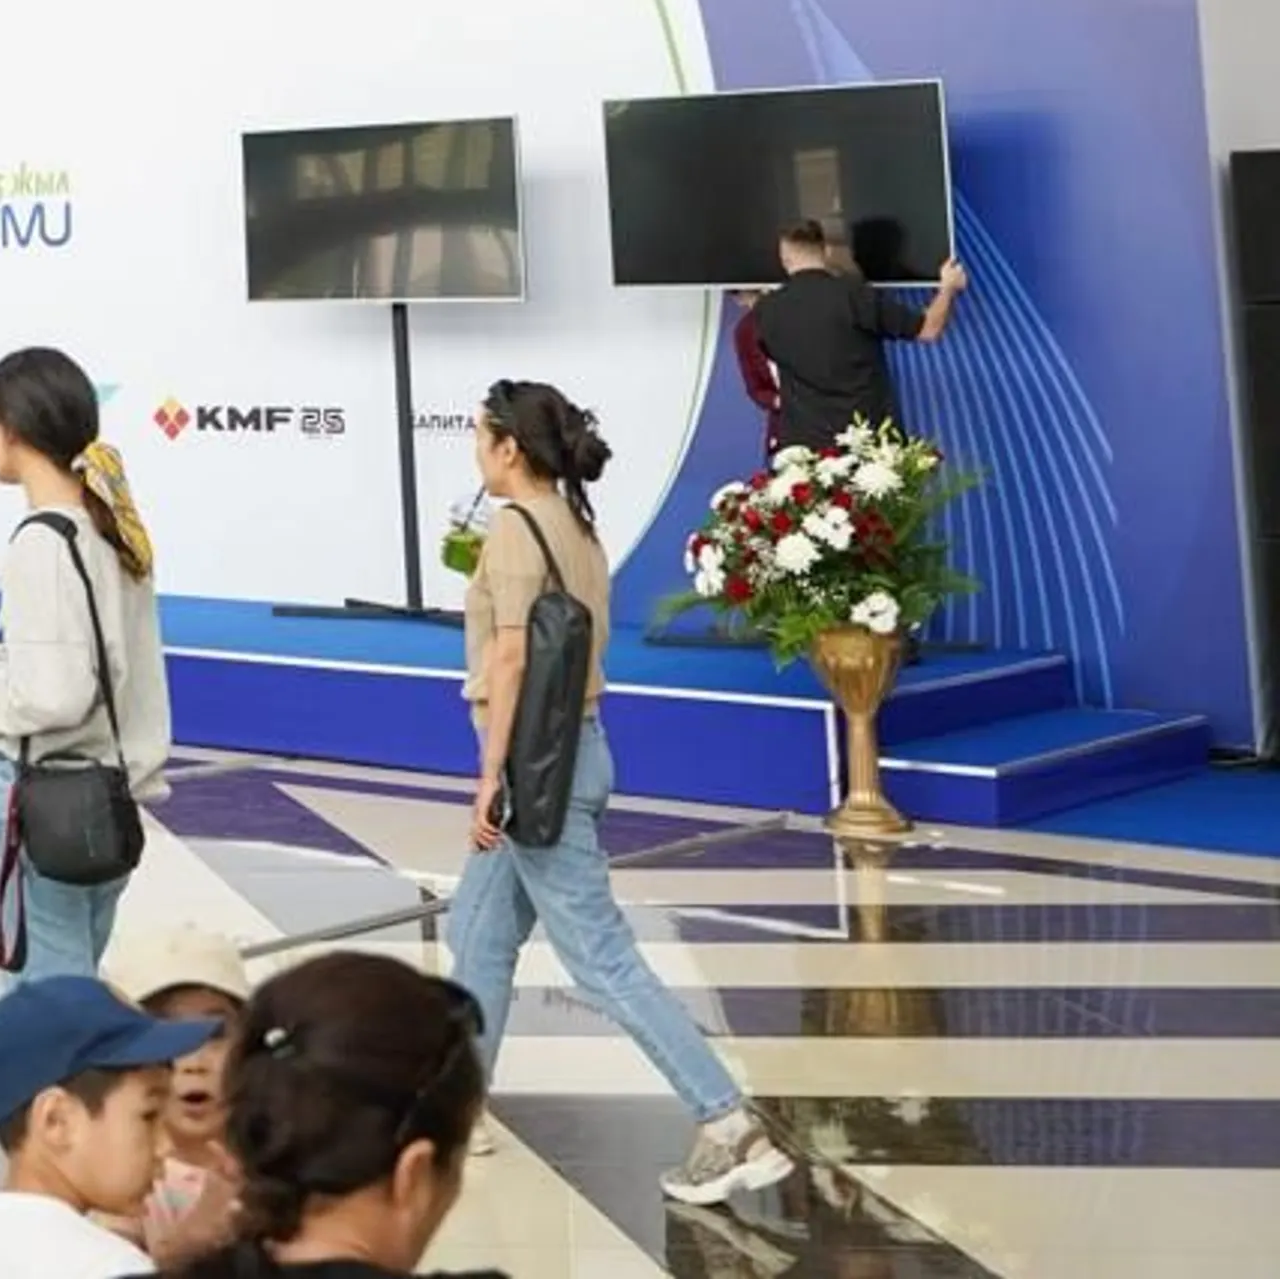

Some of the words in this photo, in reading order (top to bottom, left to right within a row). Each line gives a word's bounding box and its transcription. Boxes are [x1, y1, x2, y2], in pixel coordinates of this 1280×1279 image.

[196, 406, 293, 432] KMF
[301, 407, 345, 434] 25
[413, 414, 477, 431] АПИТА
